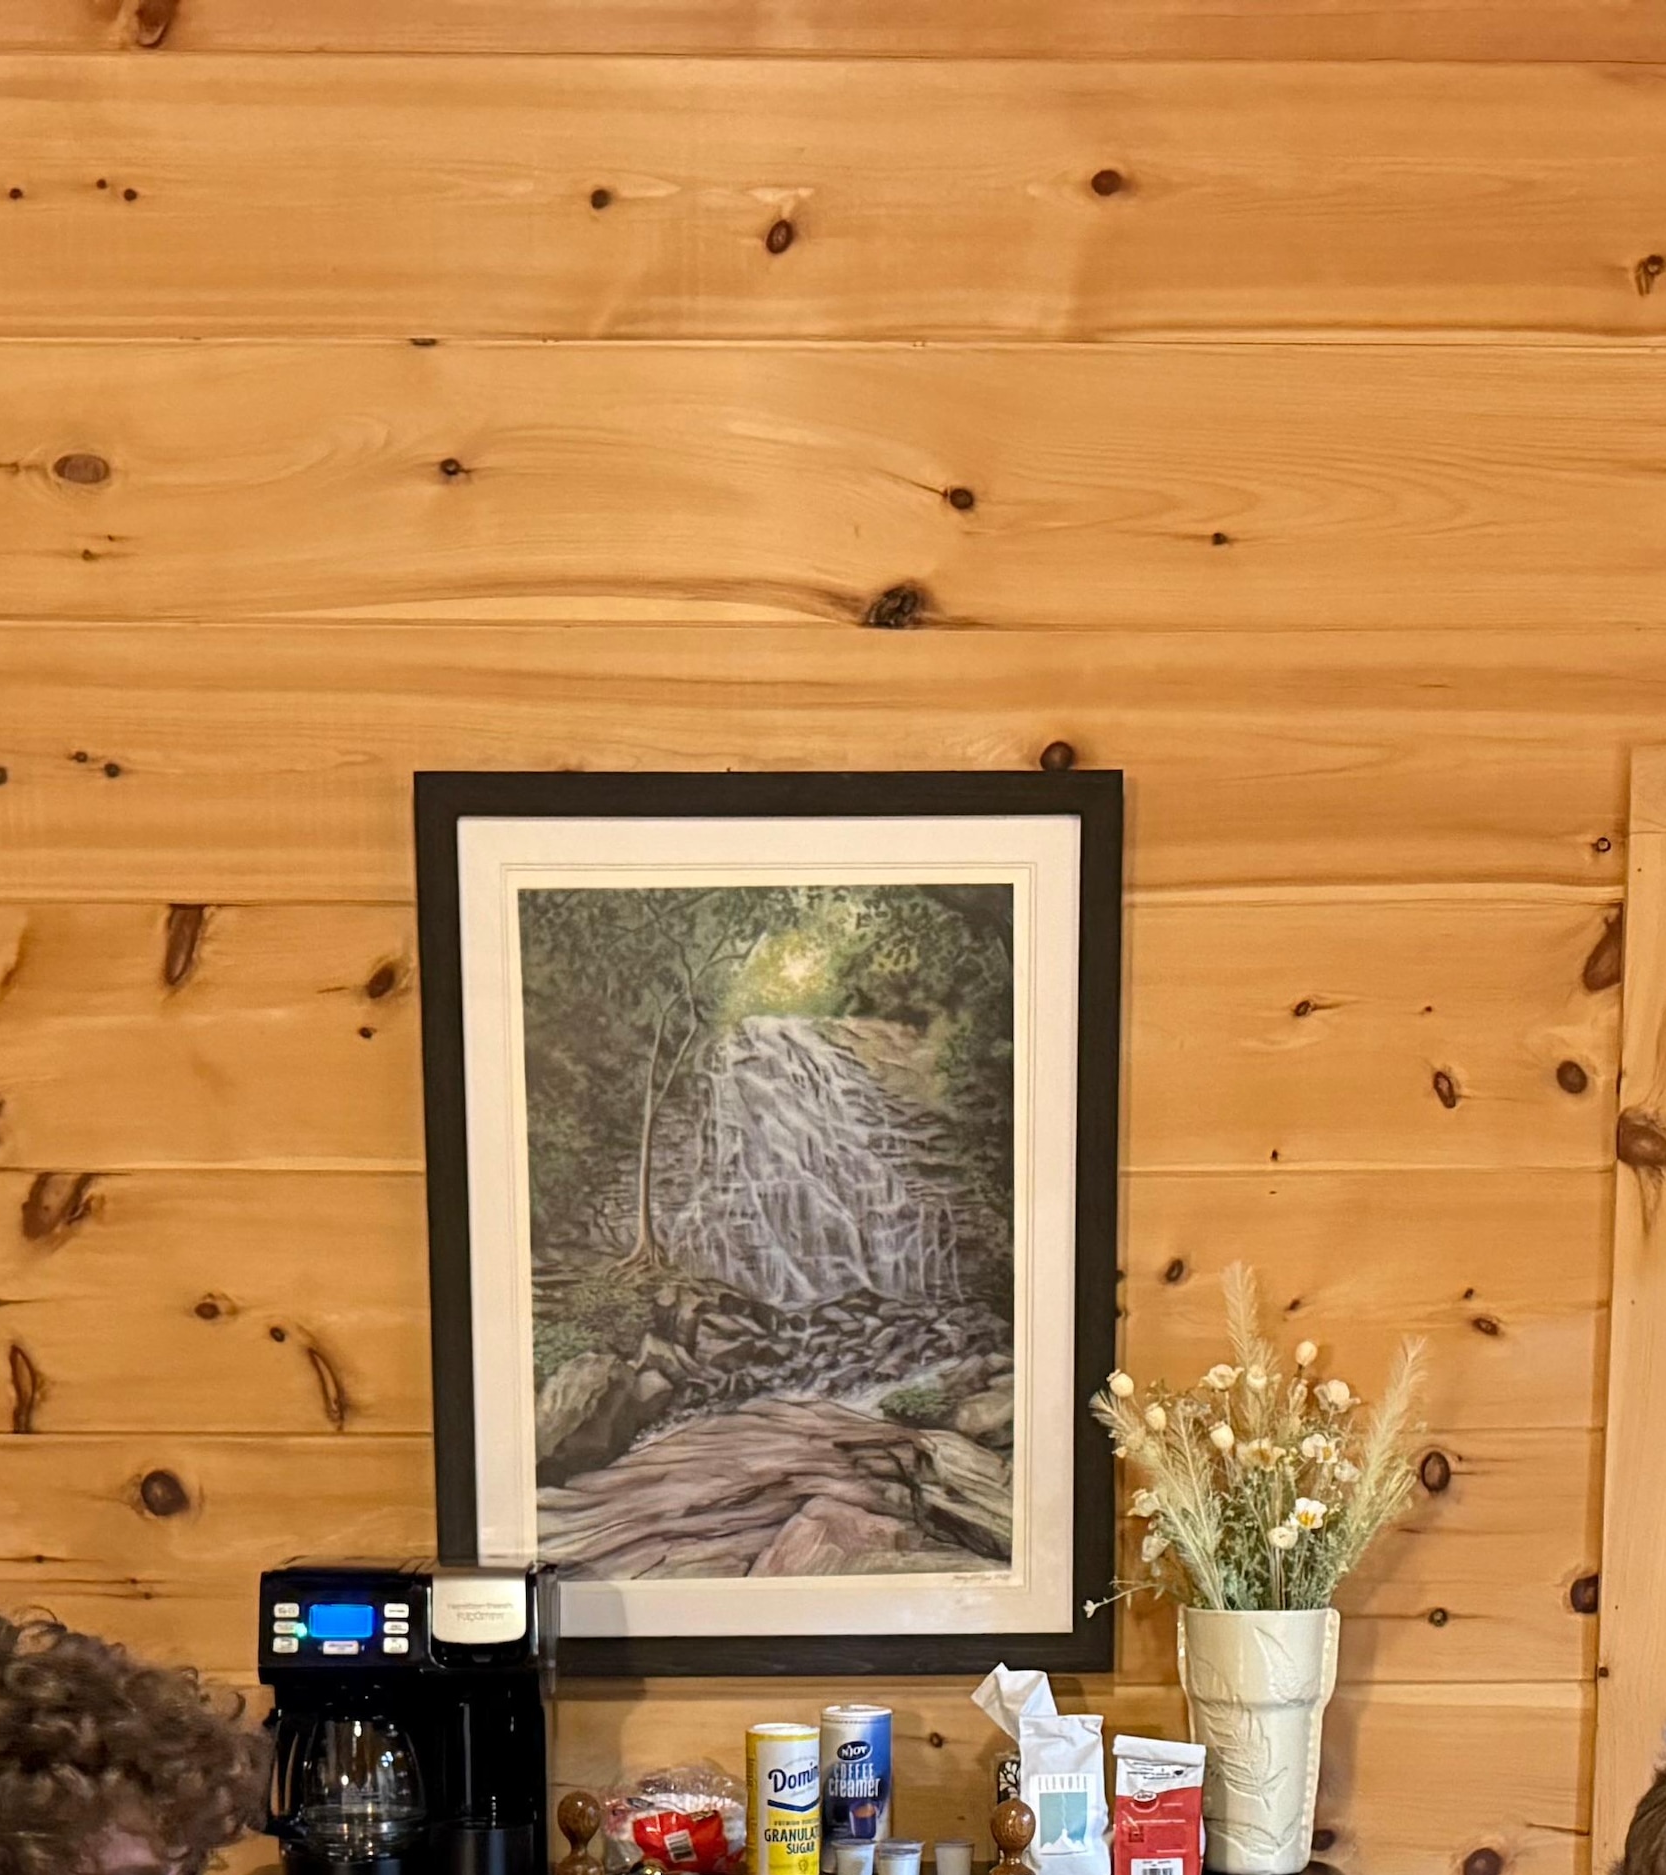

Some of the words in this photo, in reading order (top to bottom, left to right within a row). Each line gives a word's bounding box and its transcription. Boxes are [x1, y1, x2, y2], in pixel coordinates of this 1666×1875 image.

[768, 1762, 820, 1793] Domin
[834, 1763, 874, 1779] COFFEE
[828, 1777, 881, 1798] creamer
[764, 1825, 820, 1843] GRANULAT
[786, 1842, 815, 1855] SUGAR
